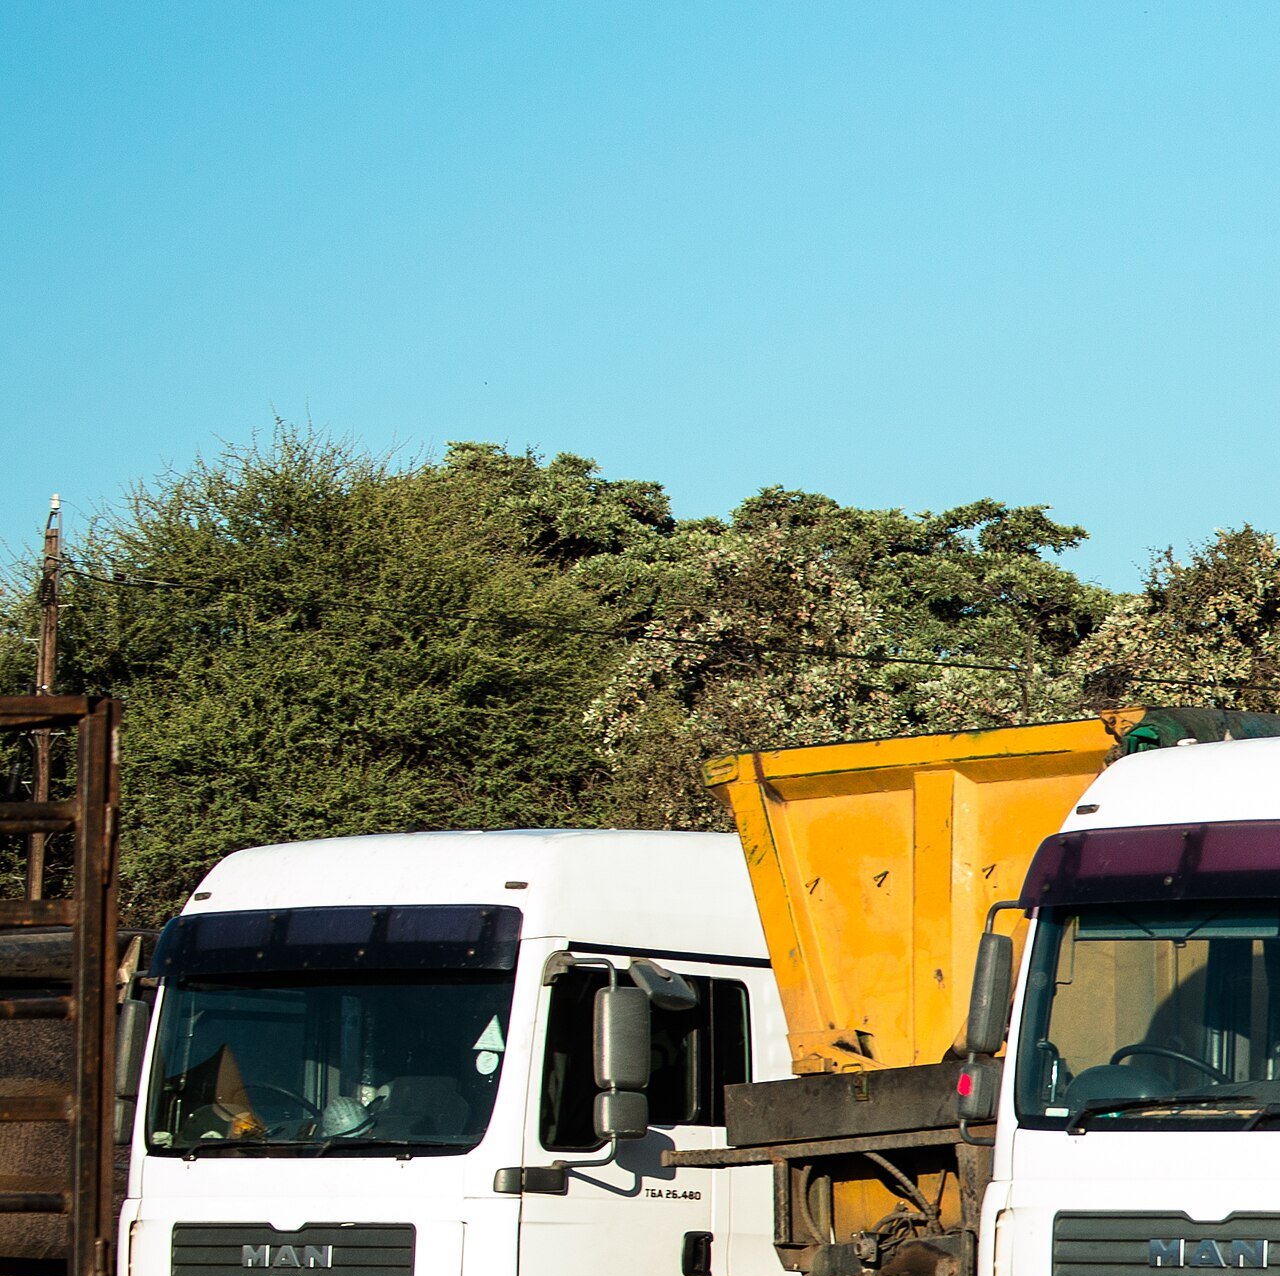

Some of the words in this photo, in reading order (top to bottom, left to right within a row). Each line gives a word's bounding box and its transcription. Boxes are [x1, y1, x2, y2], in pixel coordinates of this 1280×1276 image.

[665, 1189, 702, 1201] 26.480
[241, 1244, 333, 1268] MAN
[1148, 1238, 1269, 1267] MAN
